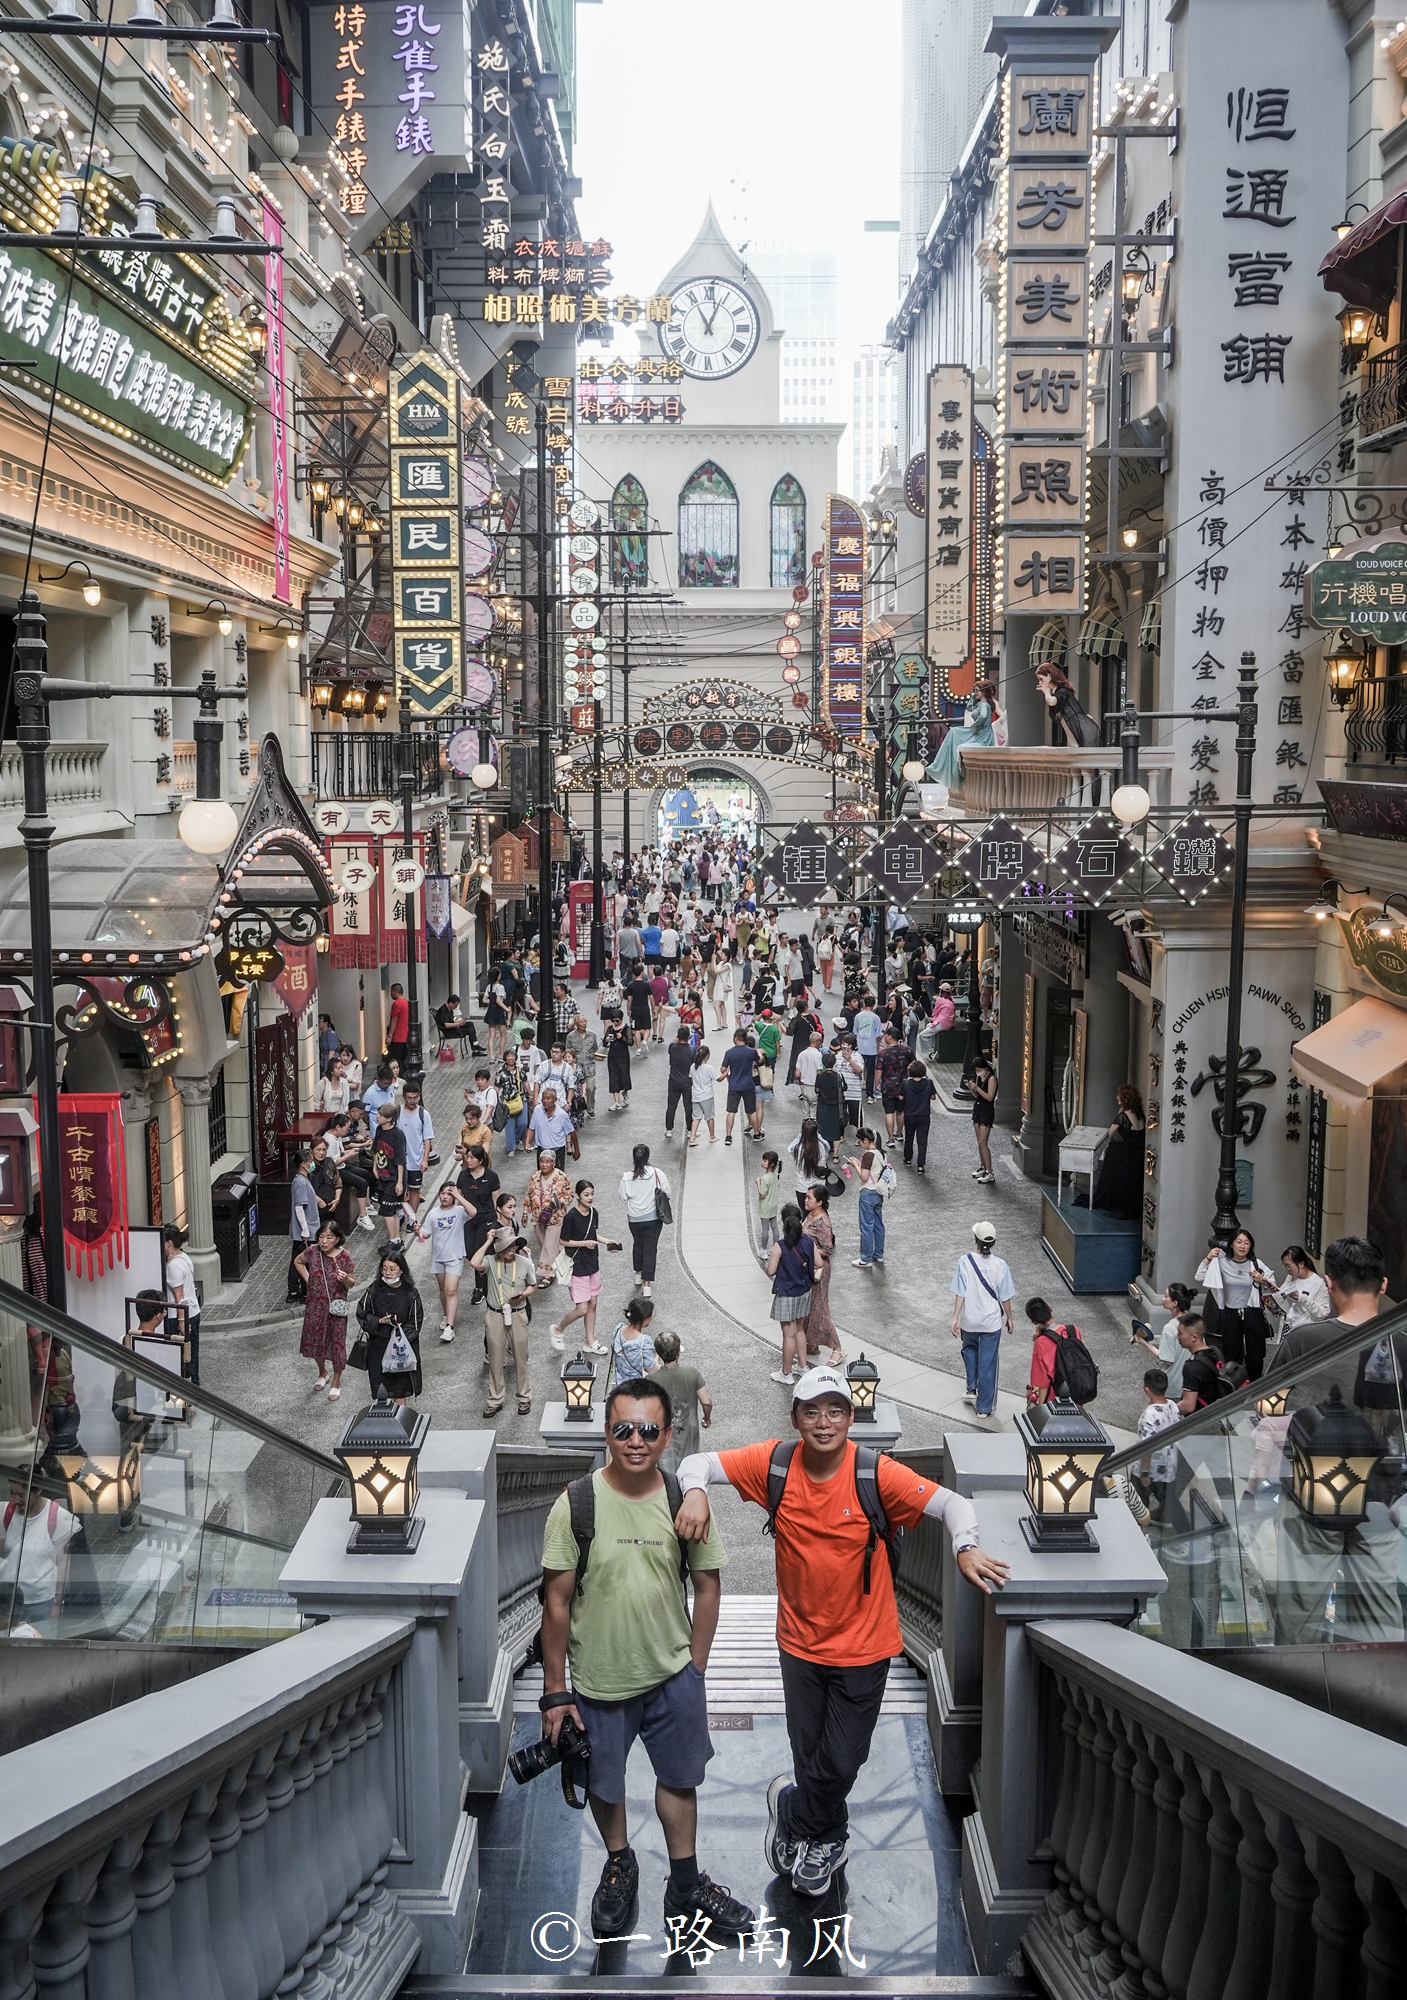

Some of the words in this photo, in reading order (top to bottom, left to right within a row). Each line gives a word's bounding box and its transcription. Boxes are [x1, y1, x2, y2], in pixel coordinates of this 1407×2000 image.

[392, 4, 442, 154] 孔雀手錶
[476, 43, 511, 251] 施氏白玉霜
[1012, 87, 1086, 595] 蘭芳美術照相
[407, 404, 441, 419] HM
[405, 461, 449, 672] 匯民百貨
[1356, 560, 1379, 569] LOUD
[1379, 560, 1403, 569] VOICE
[1350, 611, 1390, 624] LOUD
[283, 963, 308, 991] 酒
[1382, 955, 1402, 971] 7291
[1172, 996, 1205, 1034] CHUEN
[1247, 983, 1282, 1007] PAWN
[1280, 1001, 1307, 1032] SHOP
[65, 1126, 99, 1225] 千古情餐廳
